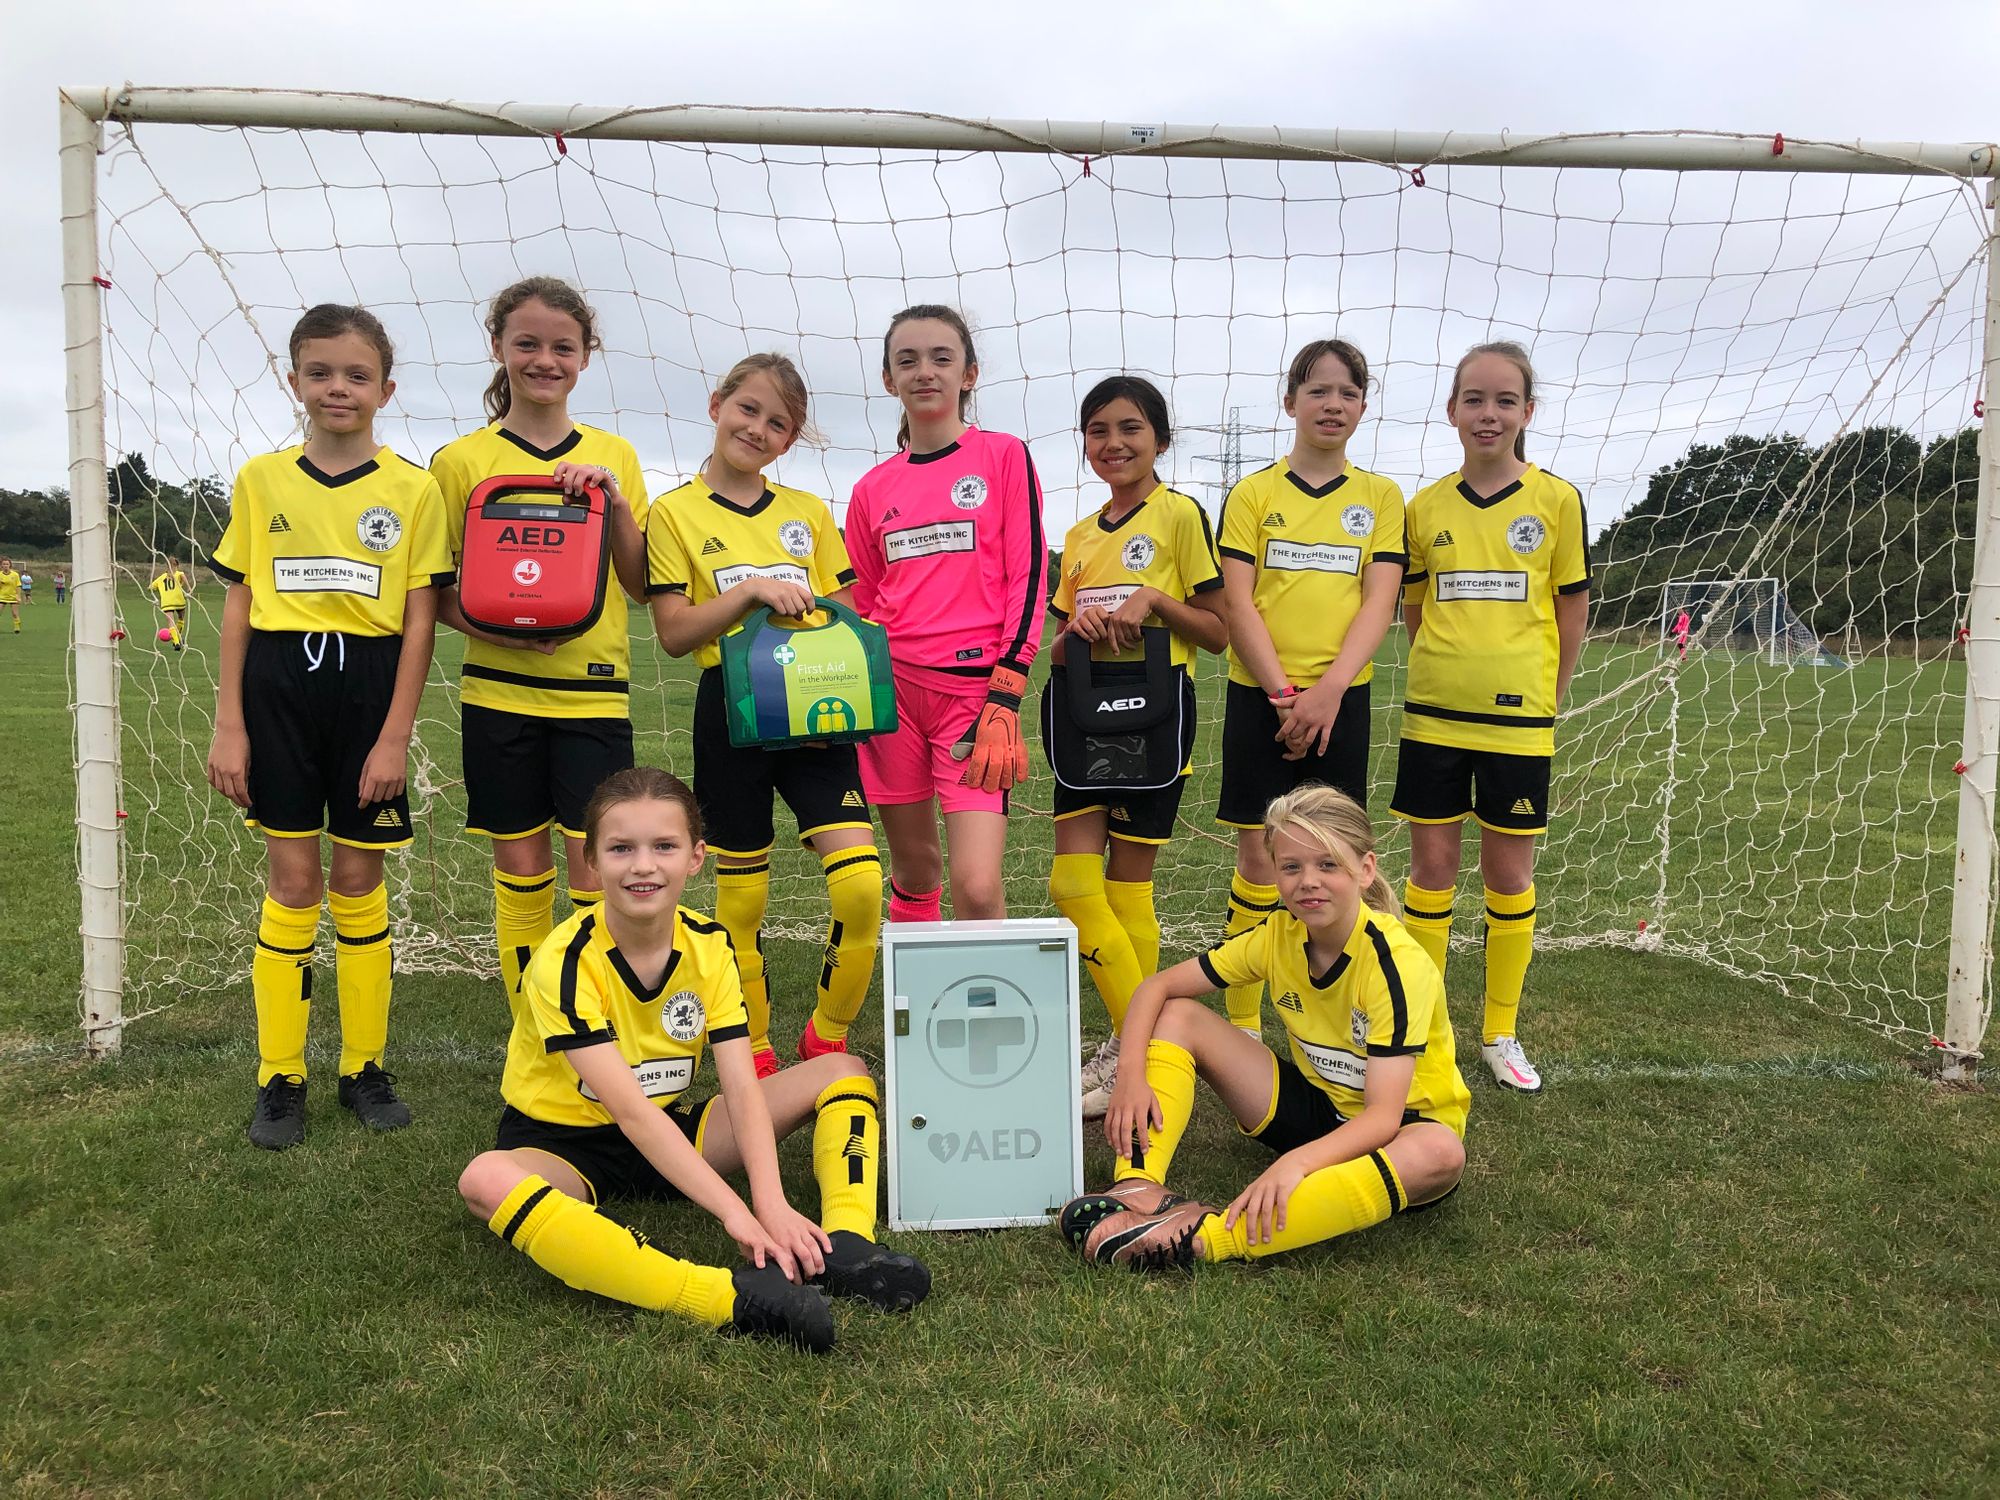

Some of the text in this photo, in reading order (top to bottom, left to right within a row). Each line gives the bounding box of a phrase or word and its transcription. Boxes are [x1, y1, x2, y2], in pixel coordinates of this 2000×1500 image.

[496, 526, 566, 547] AED
[889, 539, 906, 549] THE
[908, 531, 951, 545] KITCHENS
[953, 530, 968, 539] INC
[1272, 548, 1290, 557] THE
[1291, 551, 1336, 561] KITCHENS
[1338, 554, 1355, 562] INC
[280, 568, 374, 583] THE KITCHENS INC
[723, 574, 744, 585] THE
[163, 577, 175, 591] 10
[1443, 580, 1521, 589] THE KITCHENS INC
[1083, 594, 1117, 604] KITCHENS
[797, 660, 846, 675] First Aid
[807, 675, 820, 683] the
[820, 673, 860, 683] Workplace
[1096, 697, 1146, 713] AED
[662, 992, 695, 1016] LEAMINGTON
[671, 1030, 688, 1040] GIRLS
[665, 1069, 686, 1079] INC
[961, 1128, 1042, 1162] AED
